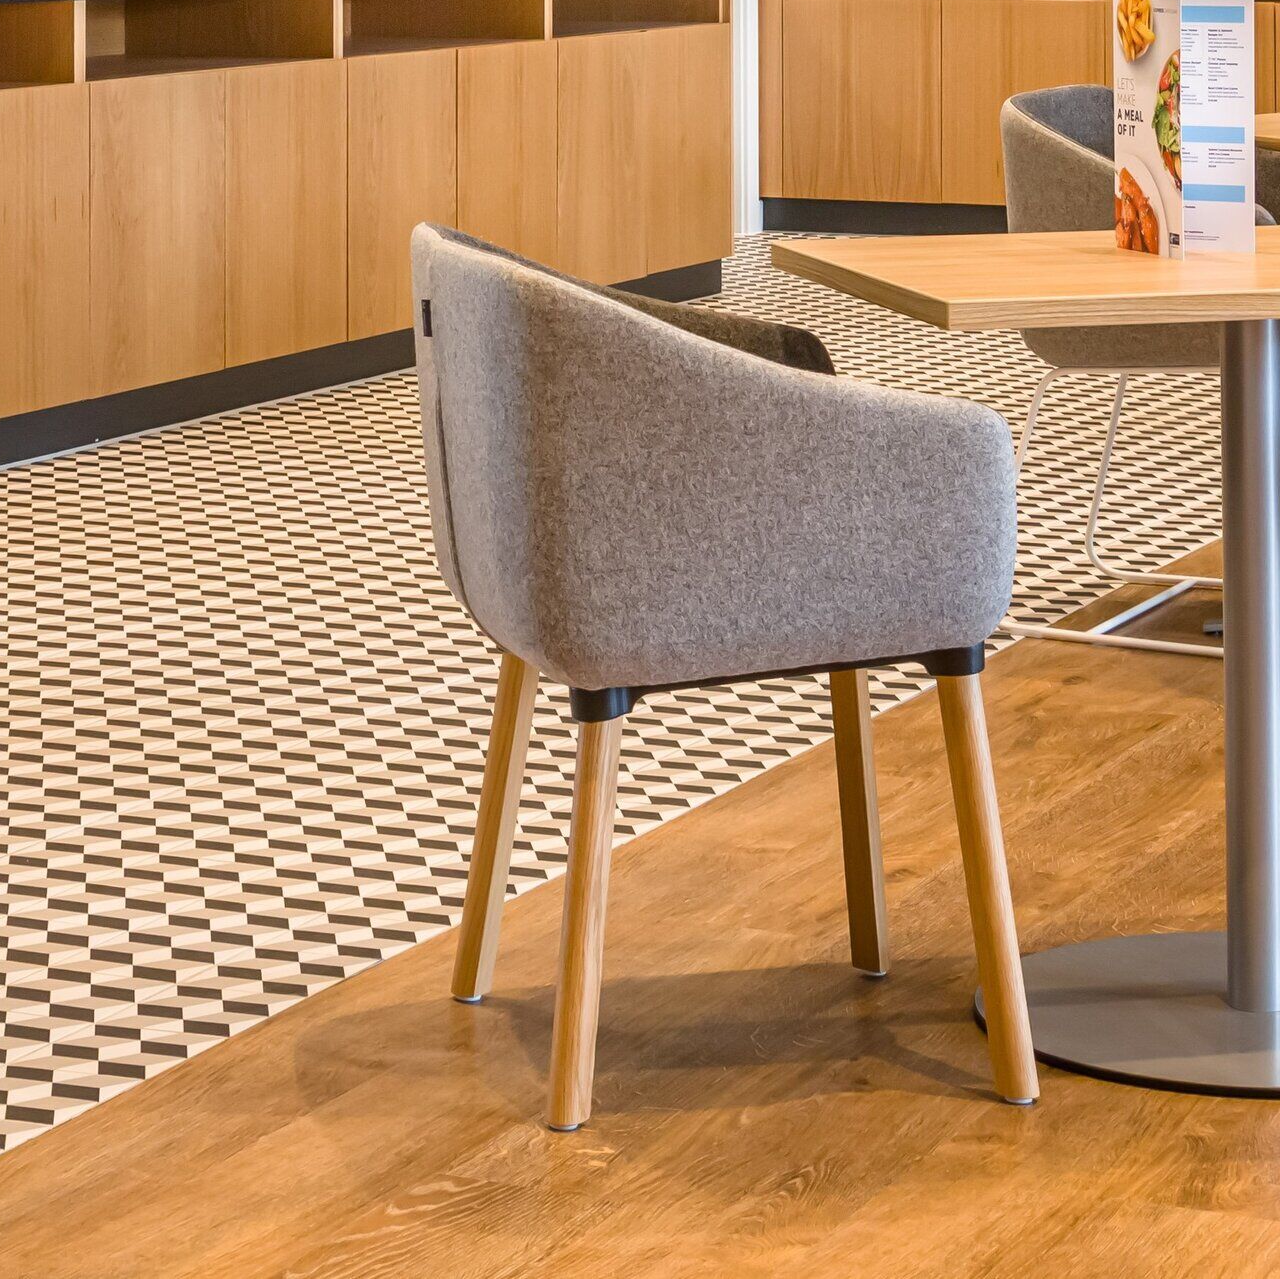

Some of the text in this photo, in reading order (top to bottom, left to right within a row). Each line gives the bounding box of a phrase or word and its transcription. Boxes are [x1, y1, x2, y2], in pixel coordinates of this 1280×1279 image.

[1117, 108, 1144, 123] A MEAL
[1117, 123, 1136, 137] OF IT
